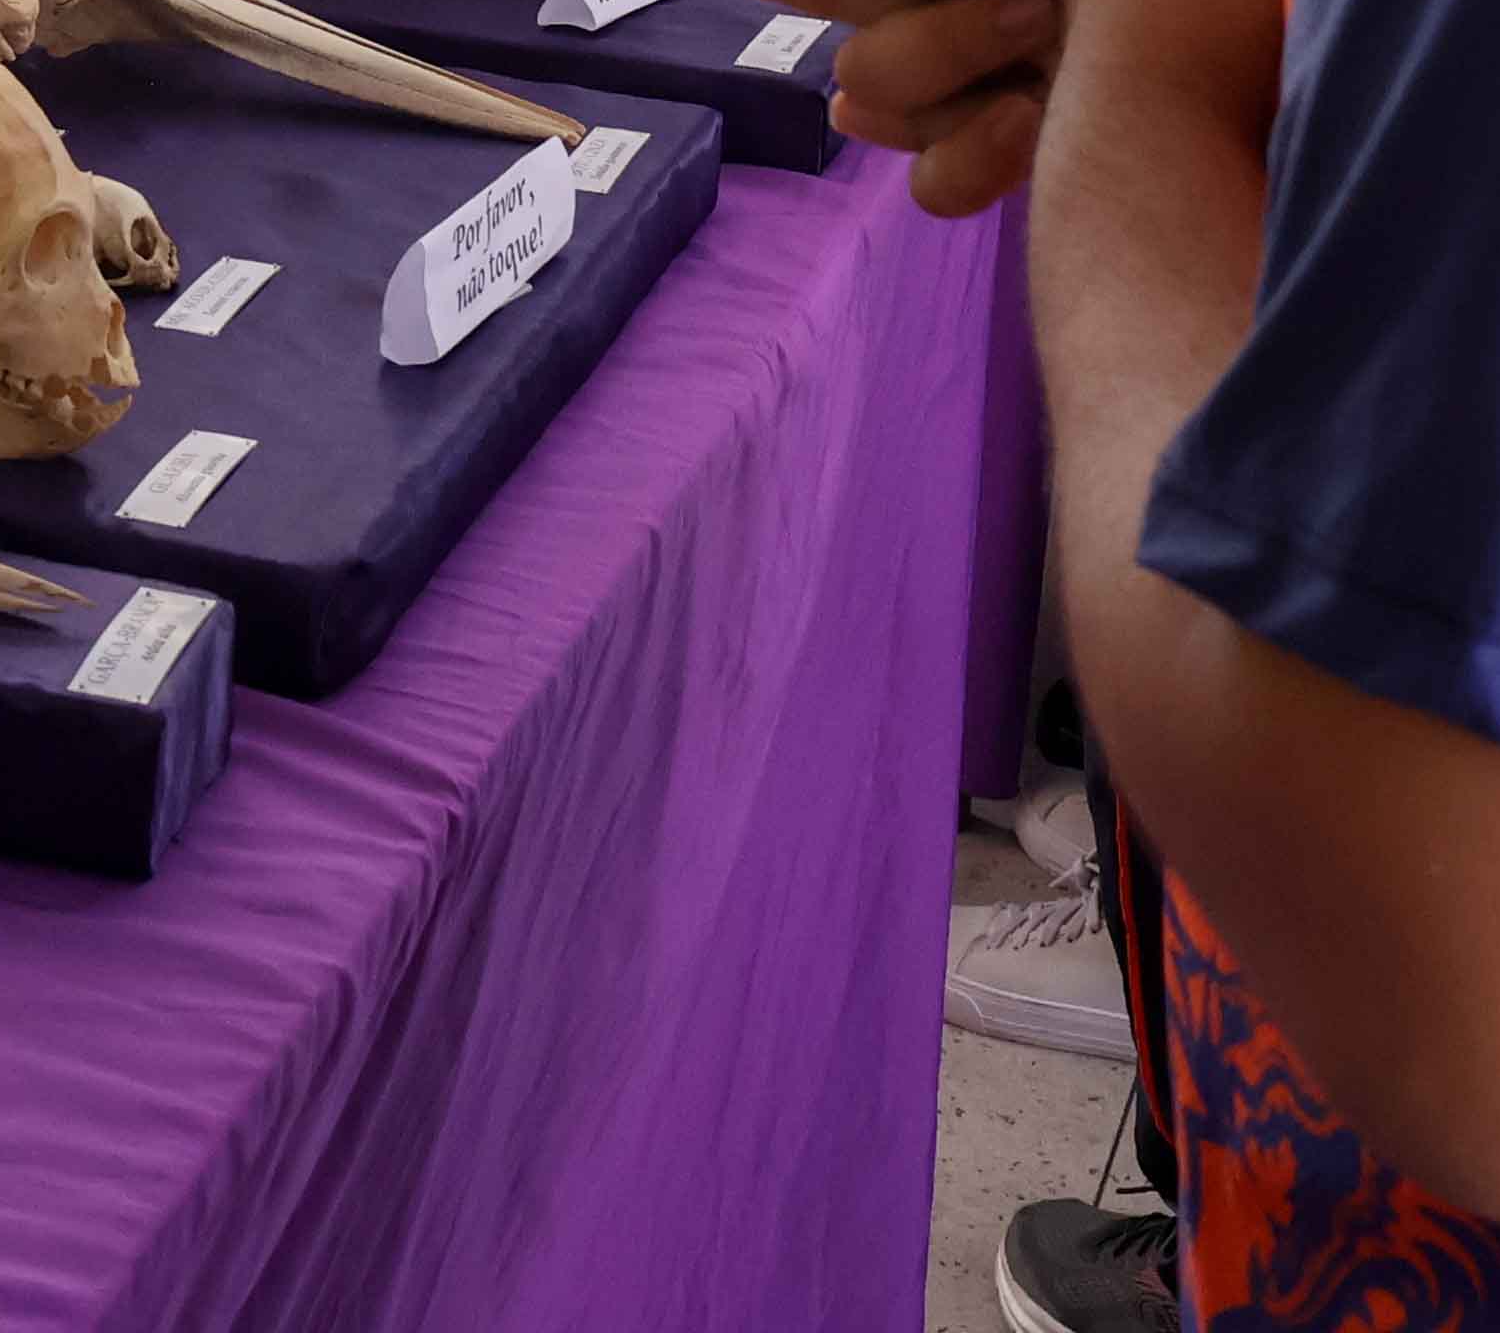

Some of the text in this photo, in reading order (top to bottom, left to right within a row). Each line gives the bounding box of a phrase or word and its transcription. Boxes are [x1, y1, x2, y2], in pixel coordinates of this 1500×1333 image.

[452, 178, 536, 261] Por favor,
[456, 215, 545, 313] não toque!
